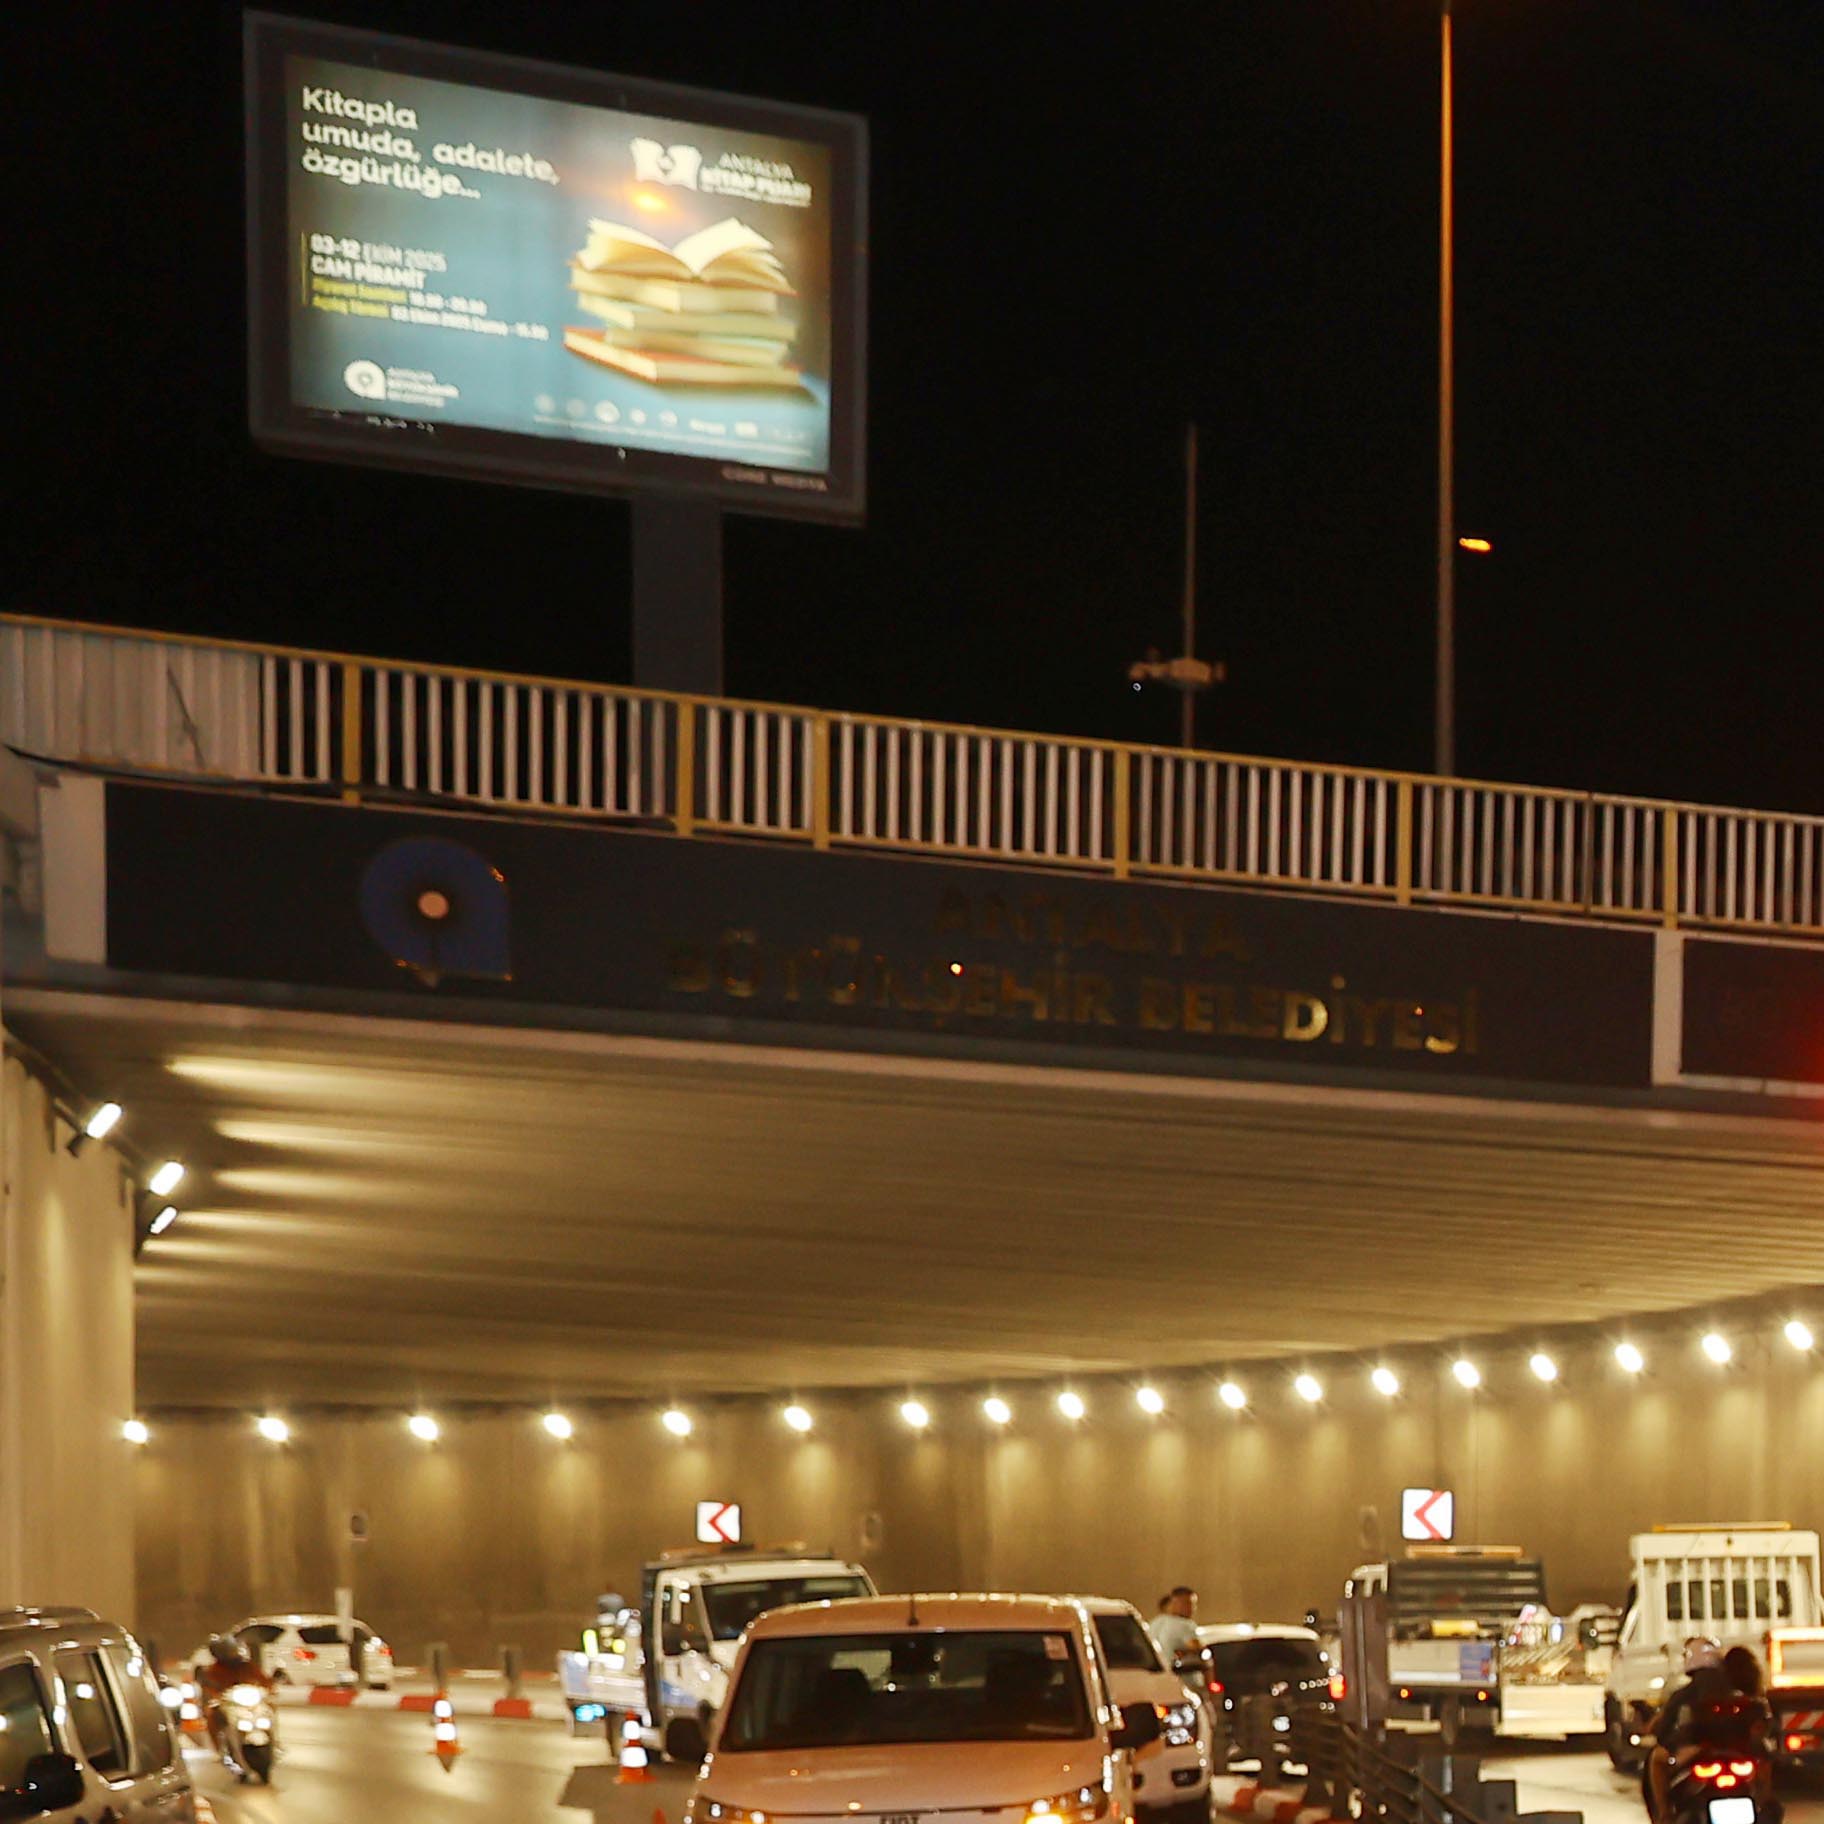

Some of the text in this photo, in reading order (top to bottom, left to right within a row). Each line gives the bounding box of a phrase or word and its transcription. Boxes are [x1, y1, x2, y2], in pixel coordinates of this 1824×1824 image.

[303, 86, 418, 130] Kitapla
[302, 122, 560, 185] umuda, adalete,
[302, 146, 481, 199] özgürlüğe...
